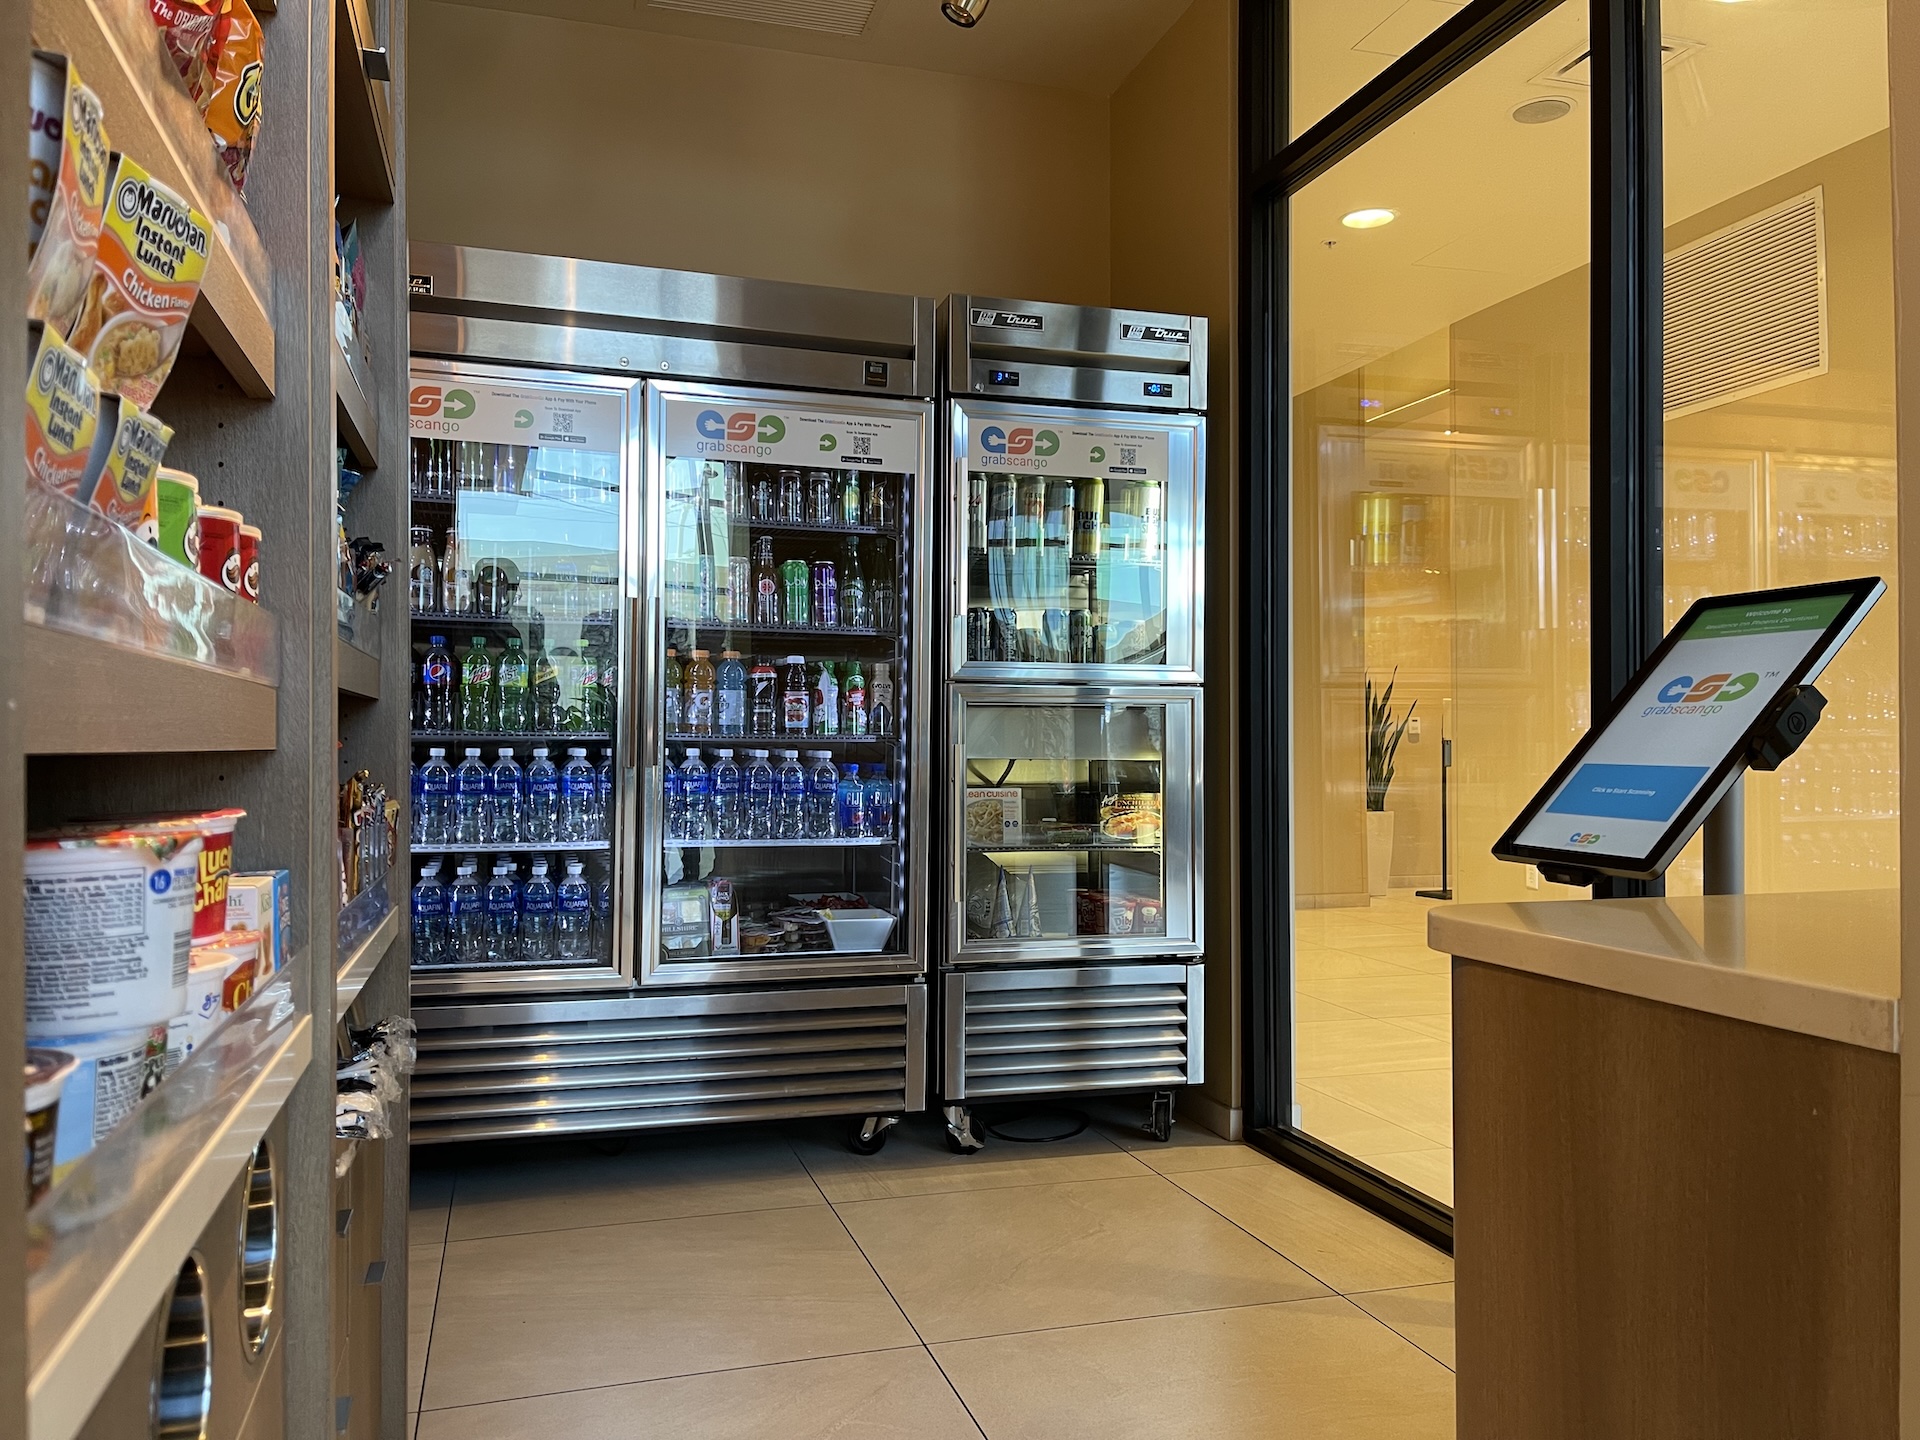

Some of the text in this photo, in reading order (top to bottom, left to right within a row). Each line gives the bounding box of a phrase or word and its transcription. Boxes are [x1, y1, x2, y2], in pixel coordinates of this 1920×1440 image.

[153, 0, 173, 20] The
[138, 183, 207, 256] Maruchan
[135, 216, 186, 264] Instant
[135, 240, 176, 280] Lunch
[123, 268, 169, 308] Chicken
[697, 440, 772, 456] grabscango
[981, 454, 1048, 470] grabscango
[1779, 615, 1819, 623] Downtown
[1641, 704, 1723, 717] grabscango
[424, 783, 449, 791] QUAFIN
[986, 790, 1018, 798] cuisine
[1627, 789, 1656, 797] Scanning
